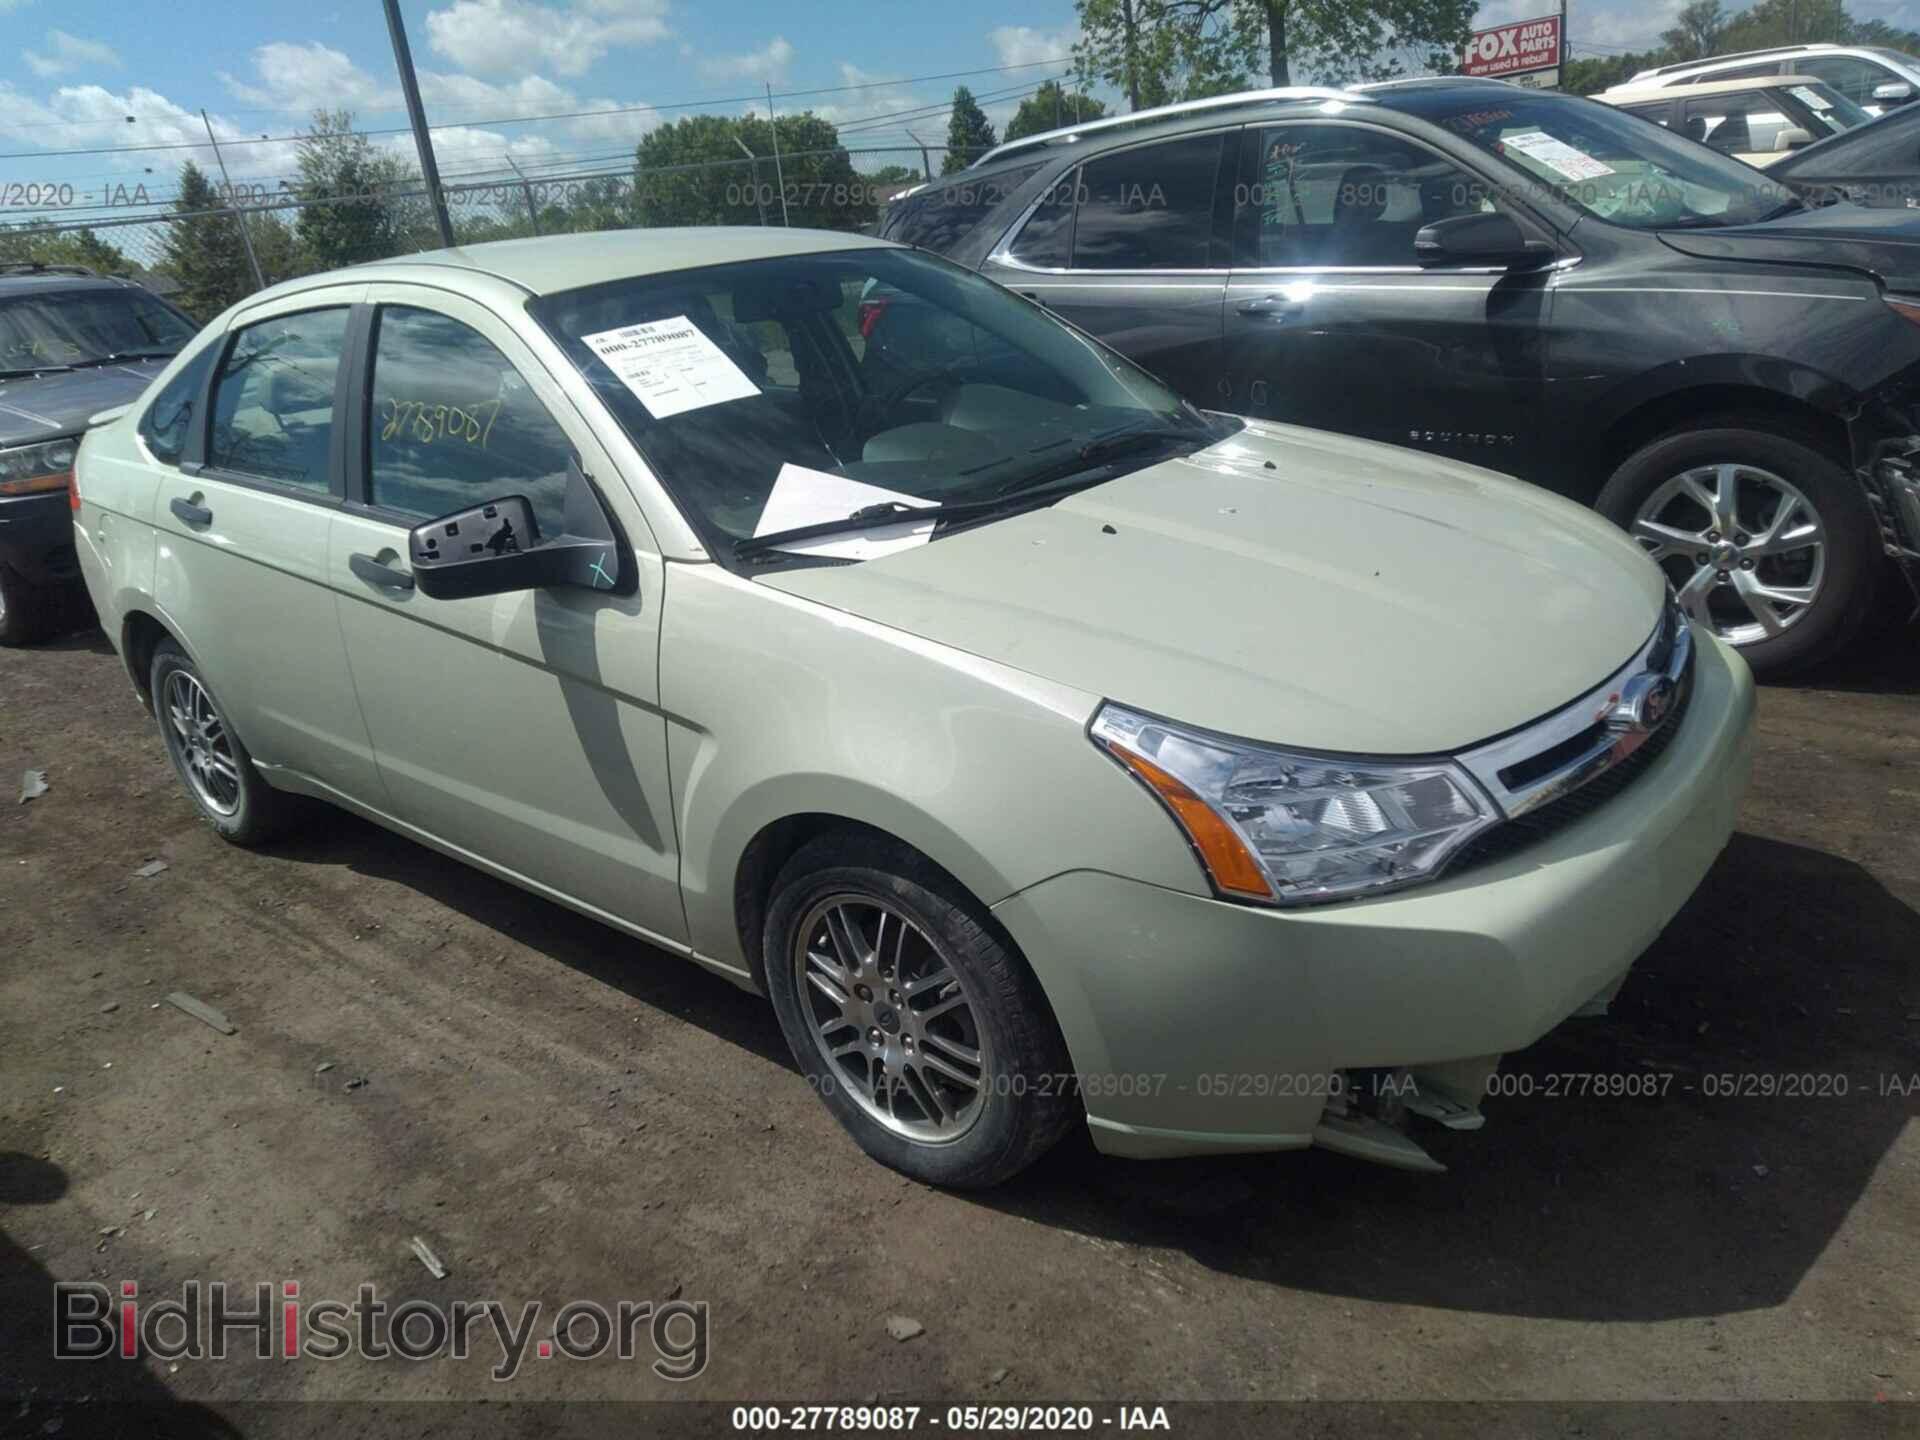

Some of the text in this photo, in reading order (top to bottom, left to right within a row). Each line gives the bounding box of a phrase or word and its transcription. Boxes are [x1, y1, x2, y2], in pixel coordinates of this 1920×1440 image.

[1521, 22, 1552, 40] AUTO
[1464, 28, 1518, 64] FOX
[1521, 36, 1556, 54] PARTS
[1470, 63, 1488, 75] new
[1490, 58, 1511, 71] used
[1512, 58, 1520, 68] &
